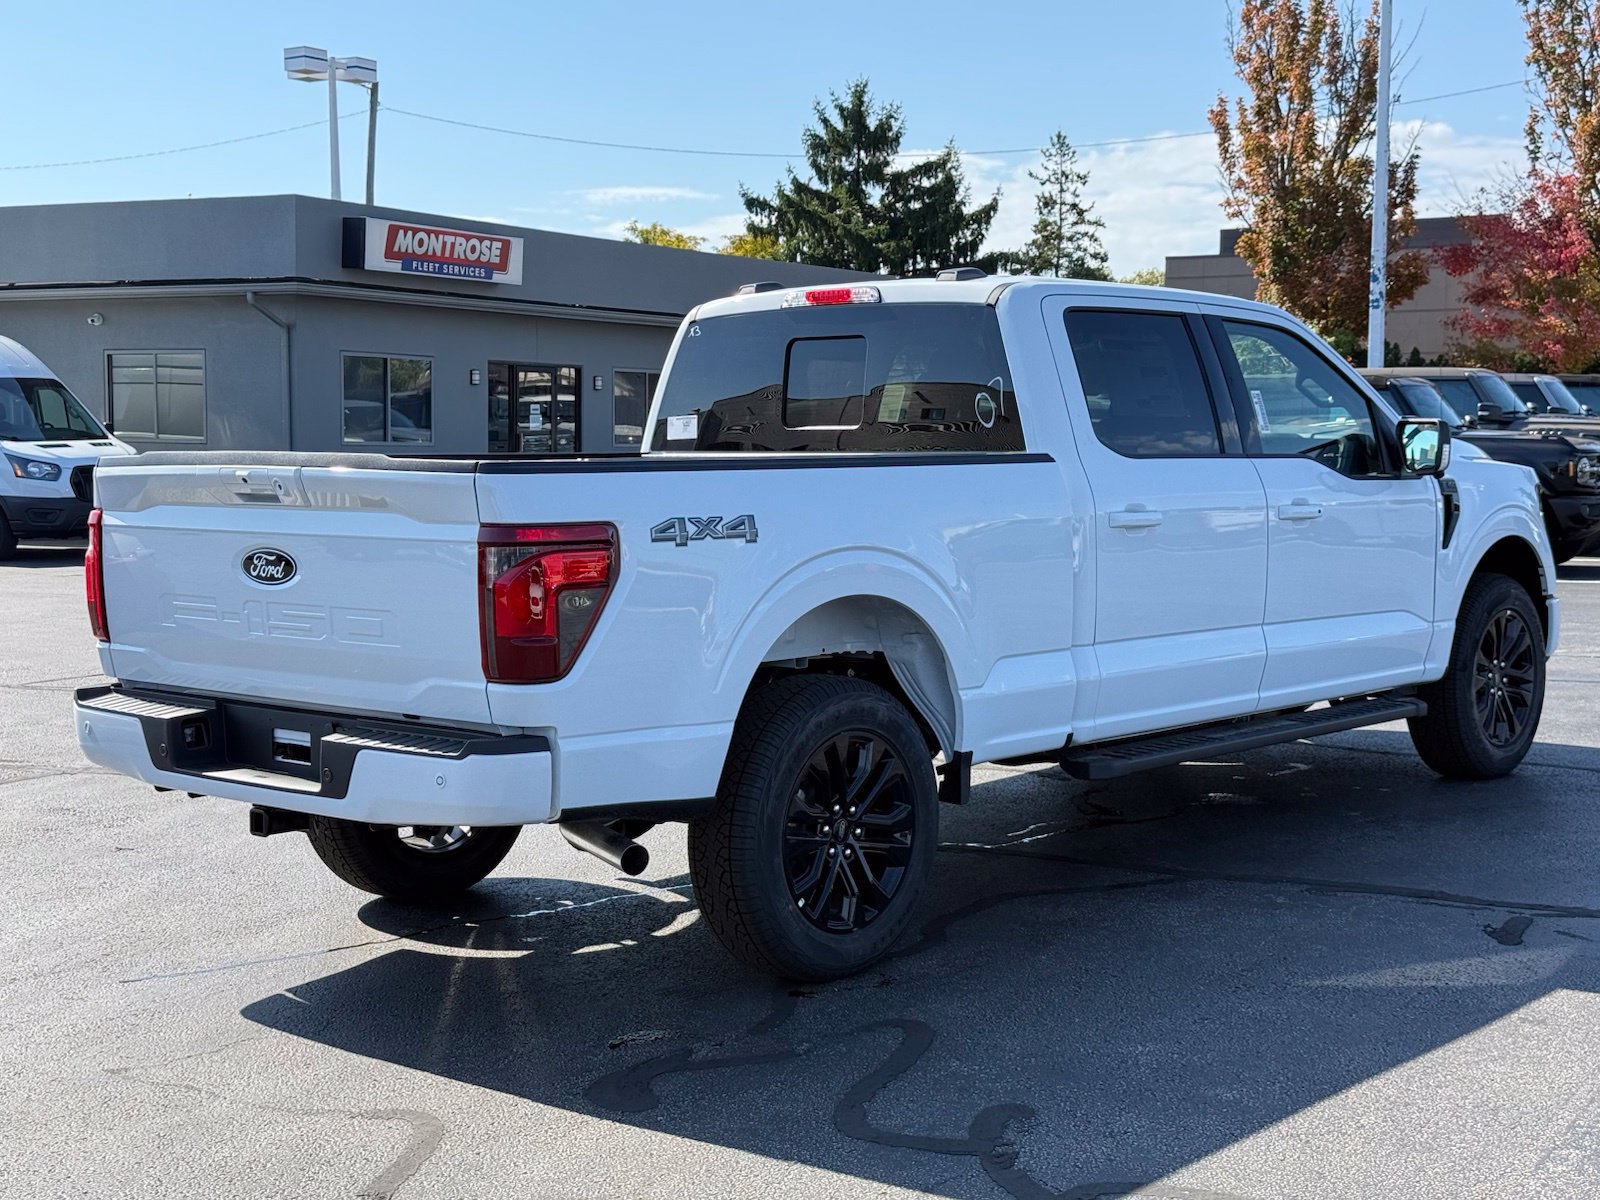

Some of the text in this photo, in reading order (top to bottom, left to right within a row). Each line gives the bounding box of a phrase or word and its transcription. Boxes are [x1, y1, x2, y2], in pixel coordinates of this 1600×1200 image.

[393, 229, 502, 264] MONTROSE
[412, 261, 486, 277] FLEET SERVICES
[250, 553, 285, 578] Ford
[160, 593, 400, 647] F-150
